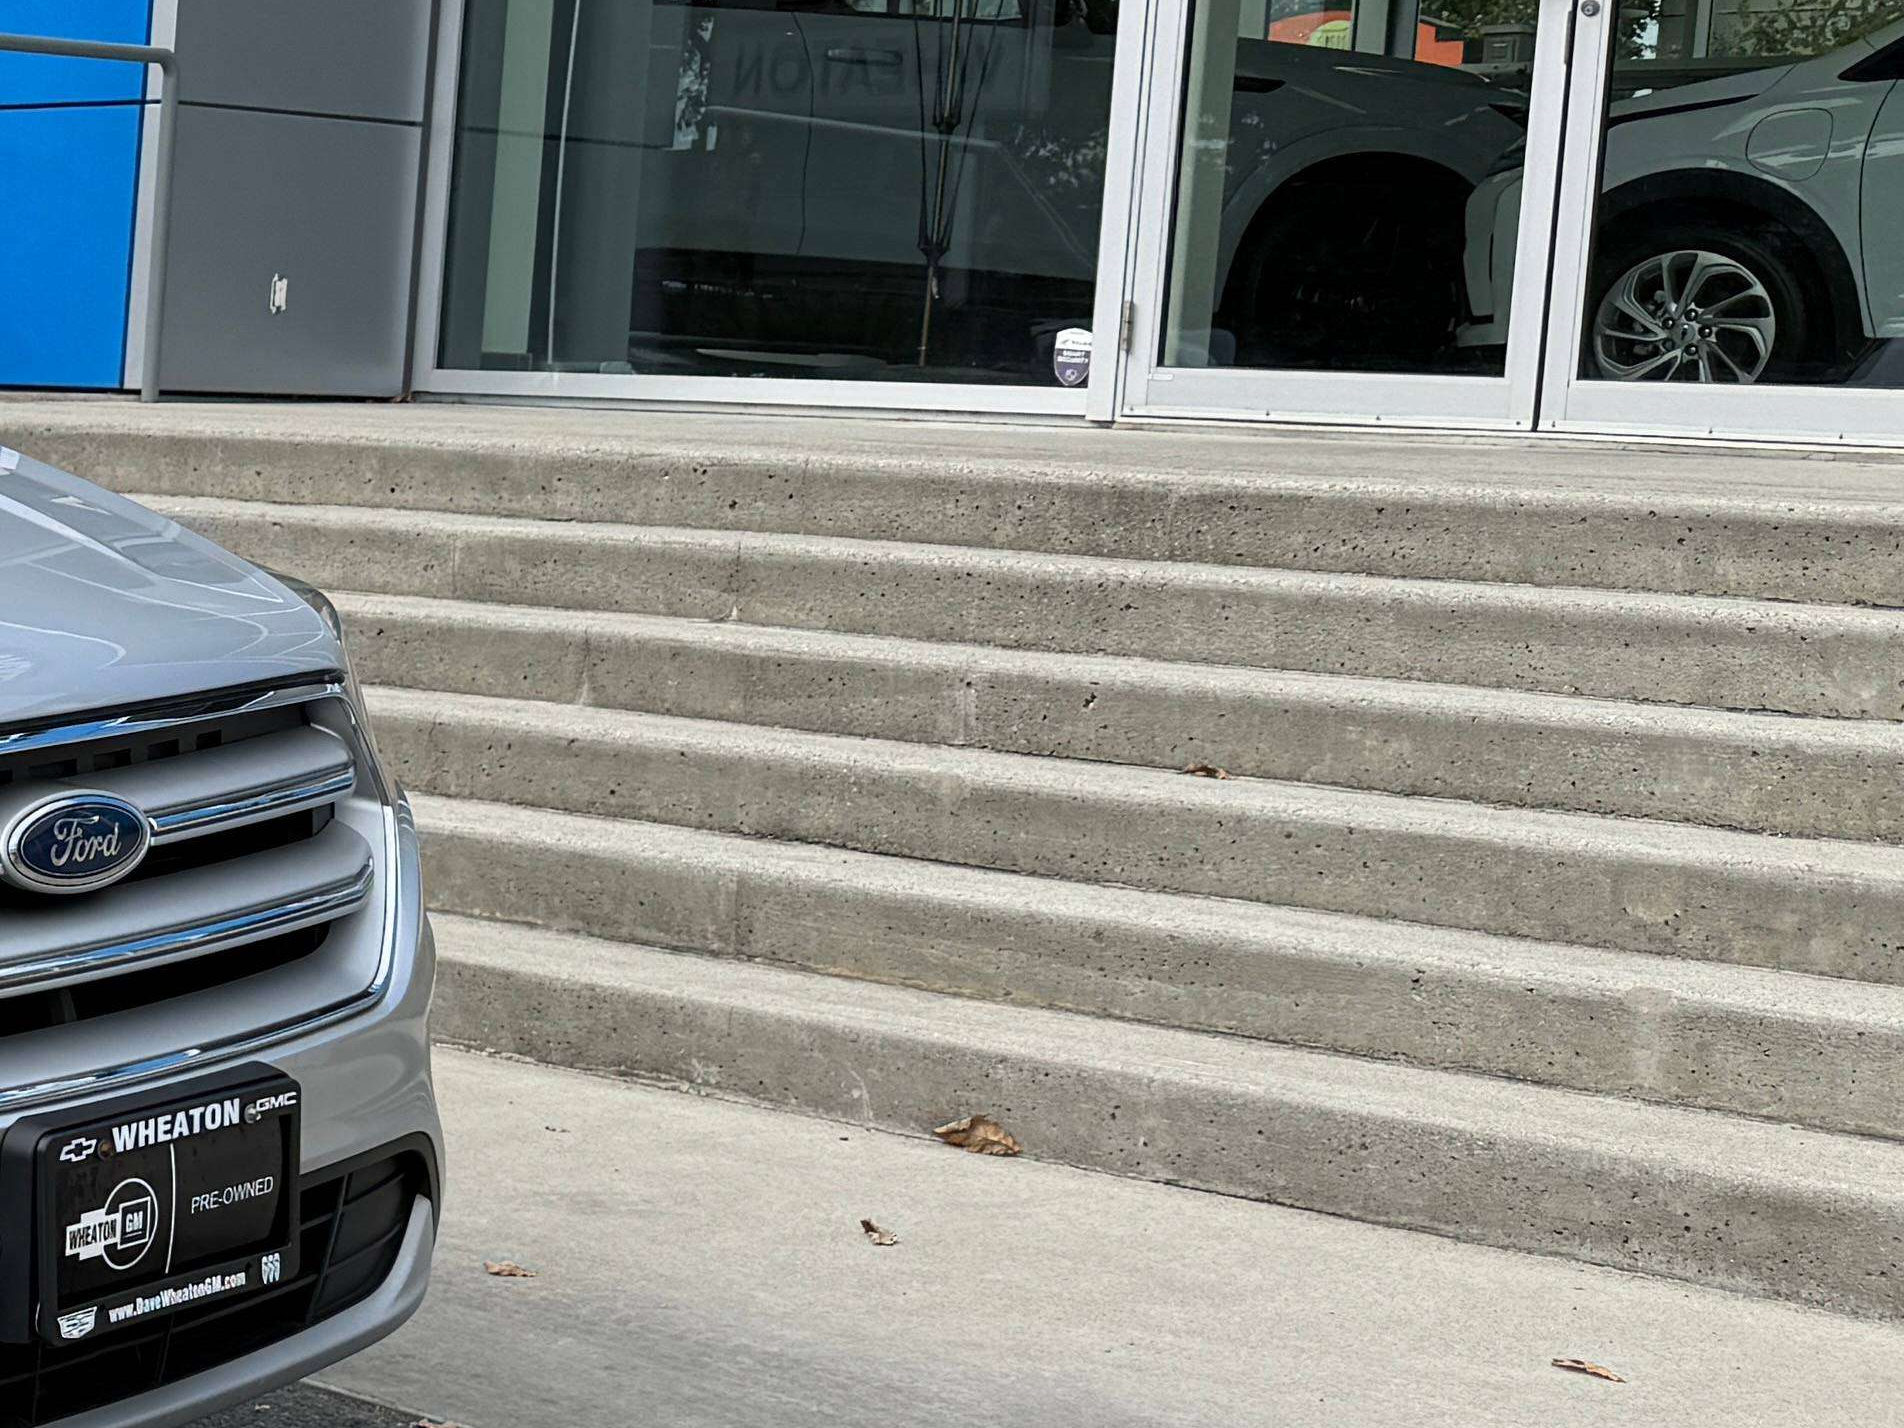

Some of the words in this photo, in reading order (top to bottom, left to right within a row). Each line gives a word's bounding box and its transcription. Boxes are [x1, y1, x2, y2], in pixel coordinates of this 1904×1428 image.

[50, 815, 122, 867] Ford
[255, 1091, 298, 1113] GMC
[112, 1098, 240, 1153] WHEATON
[191, 1176, 274, 1215] PRE-OWNED
[69, 1218, 117, 1250] WHEATON
[125, 1210, 143, 1232] GM
